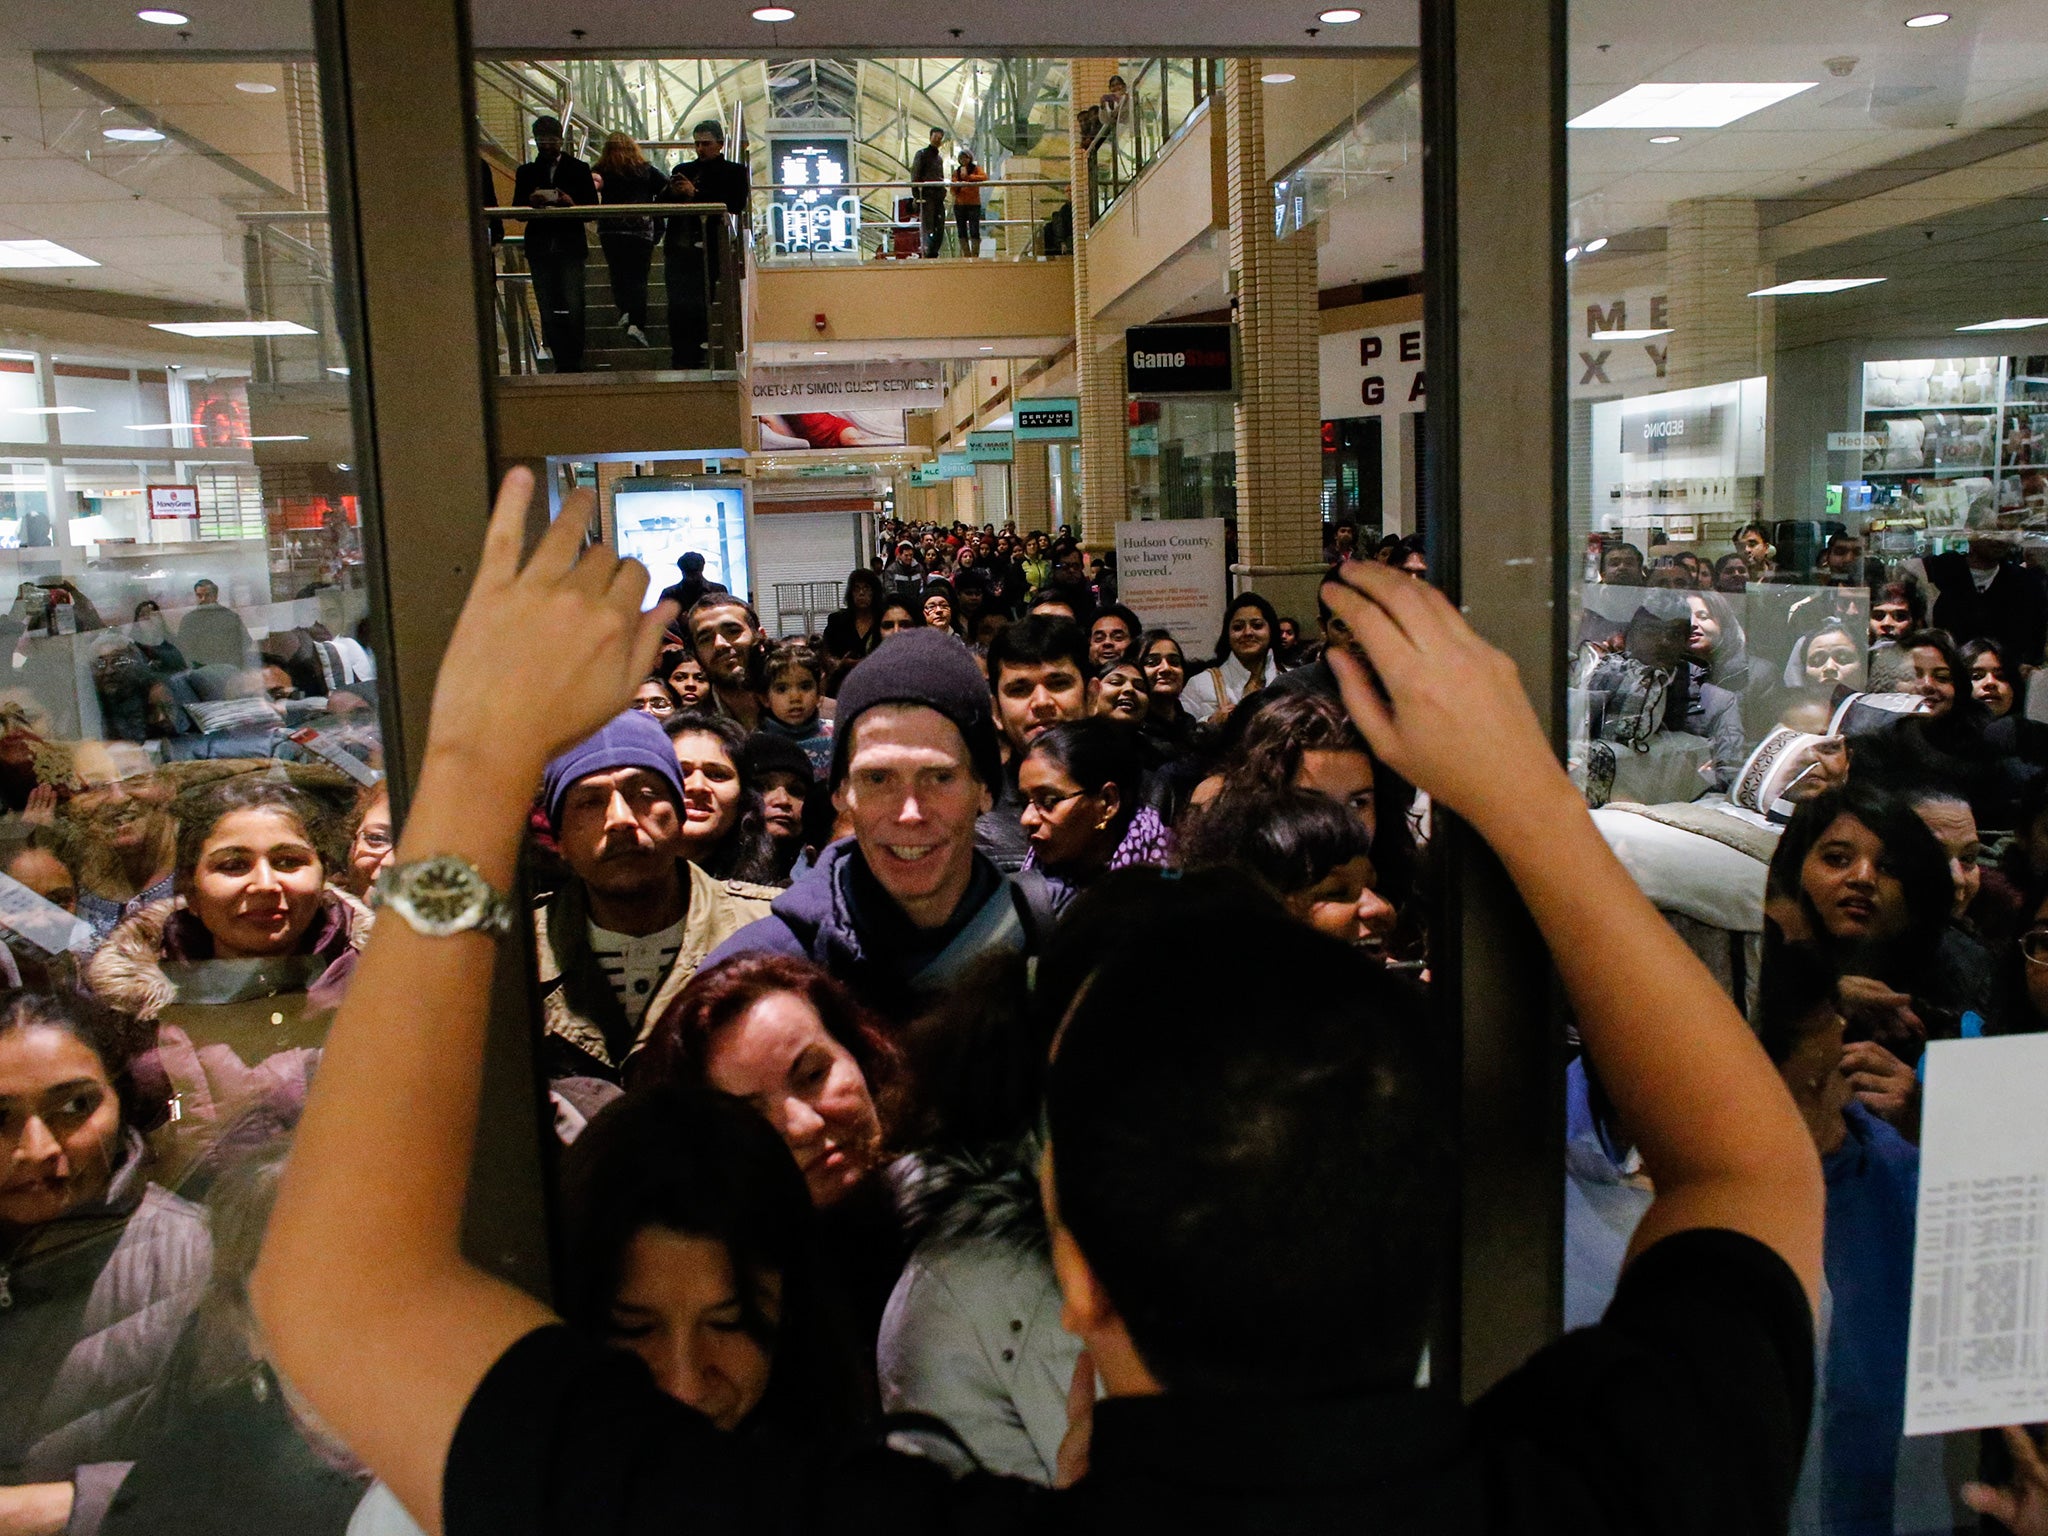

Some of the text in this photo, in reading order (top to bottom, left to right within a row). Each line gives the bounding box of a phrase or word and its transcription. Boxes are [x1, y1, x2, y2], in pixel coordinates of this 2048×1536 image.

[751, 377, 935, 398] CKETS AT SIMON GUEST SERVICES
[156, 500, 192, 508] MoneyGram
[1123, 537, 1166, 548] Hudson
[1143, 551, 1168, 562] have
[1172, 553, 1192, 564] you
[1124, 566, 1172, 577] covered.
